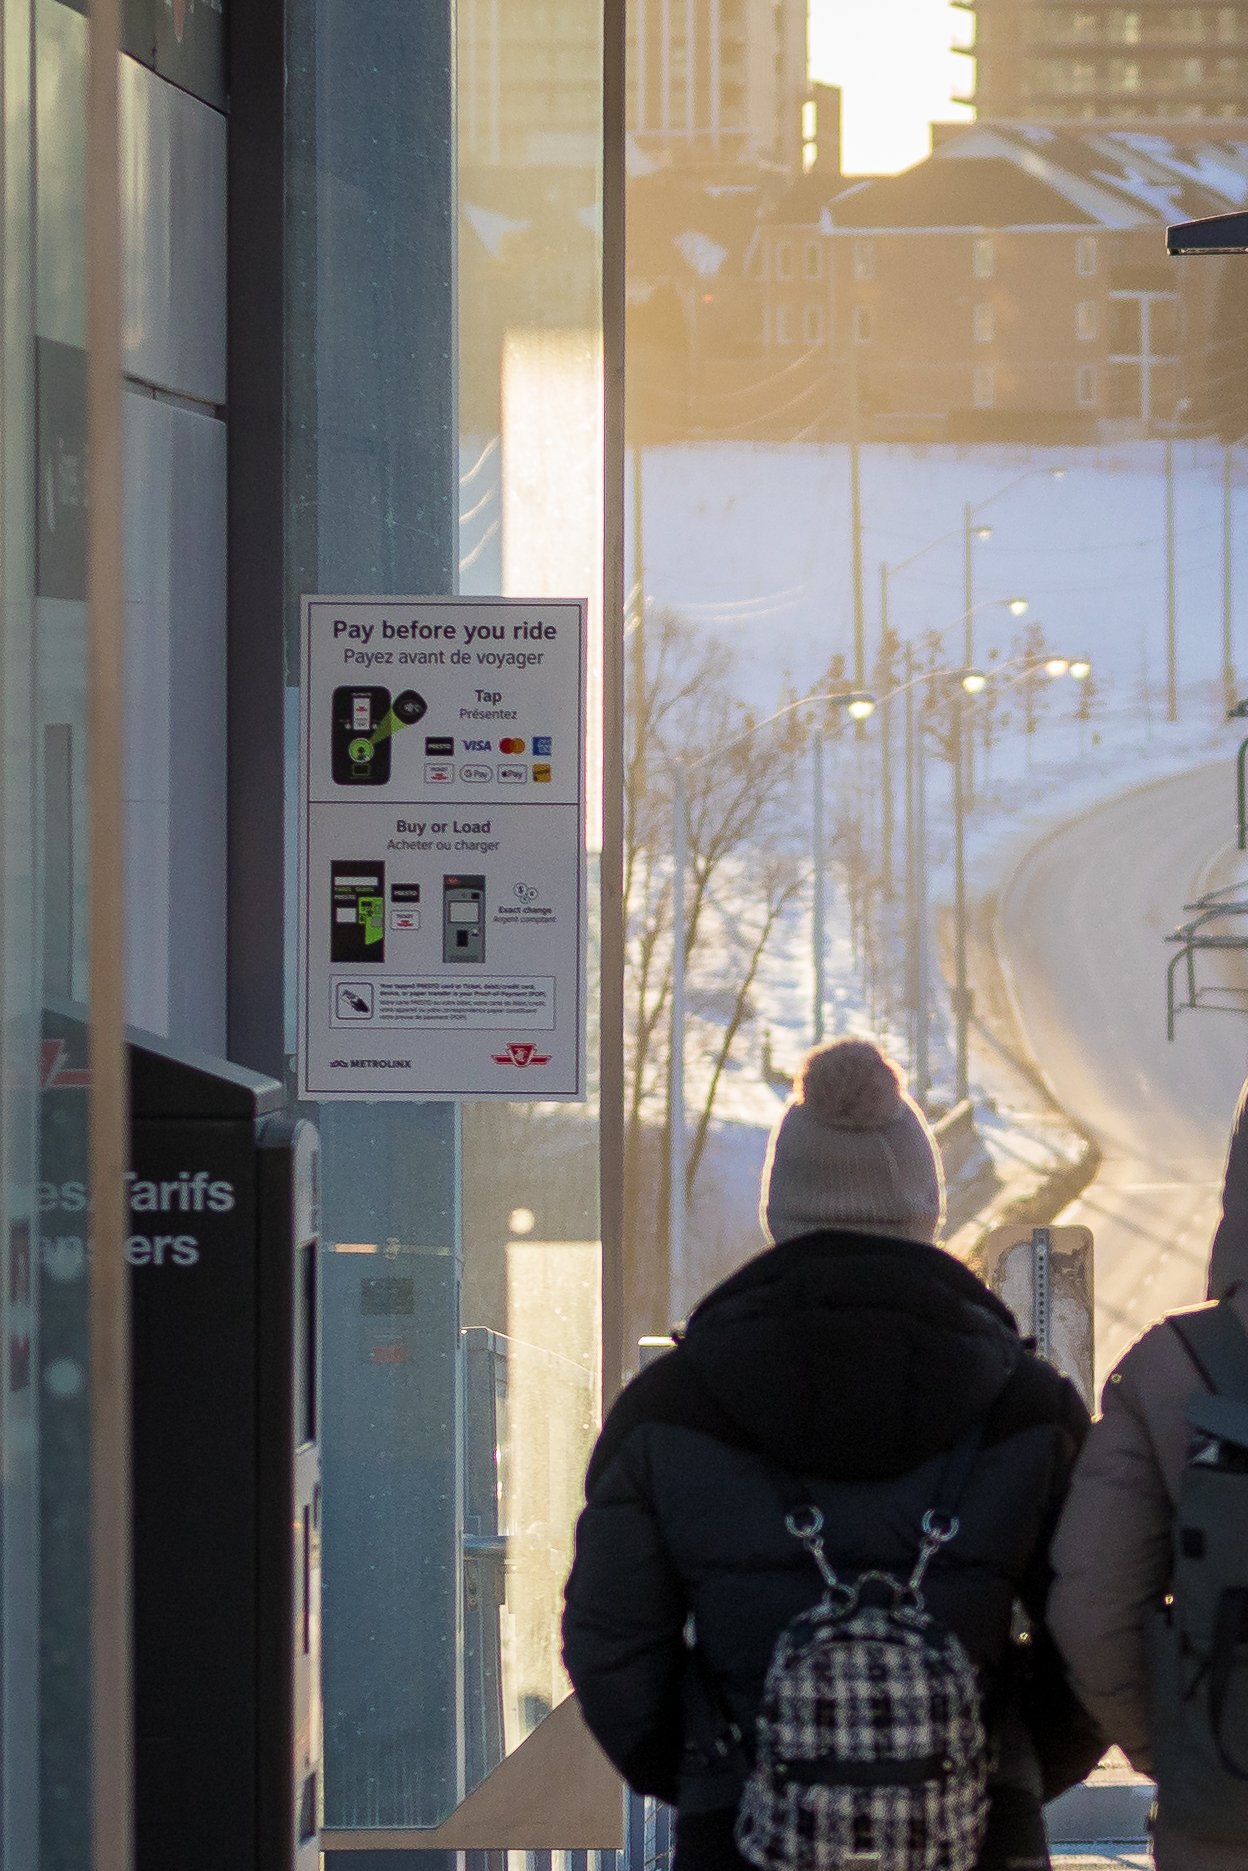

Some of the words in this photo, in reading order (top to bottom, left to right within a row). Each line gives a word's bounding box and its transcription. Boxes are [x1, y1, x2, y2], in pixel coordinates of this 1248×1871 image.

[333, 620, 375, 644] Pay
[382, 620, 457, 641] before
[463, 624, 505, 644] you
[513, 621, 557, 641] ride
[343, 649, 394, 668] Payez
[398, 650, 445, 665] avant
[450, 649, 471, 665] de
[477, 651, 544, 669] voyager
[474, 690, 502, 705] Tap
[459, 708, 517, 721] Présentez
[462, 740, 492, 752] VISA
[396, 820, 426, 836] Buy
[431, 823, 448, 834] or
[453, 820, 491, 834] Load
[387, 840, 433, 851] Acheter
[436, 841, 451, 851] ou
[454, 840, 500, 853] charger
[498, 906, 522, 914] Exact
[523, 906, 552, 916] change
[349, 1059, 412, 1069] METROLINX
